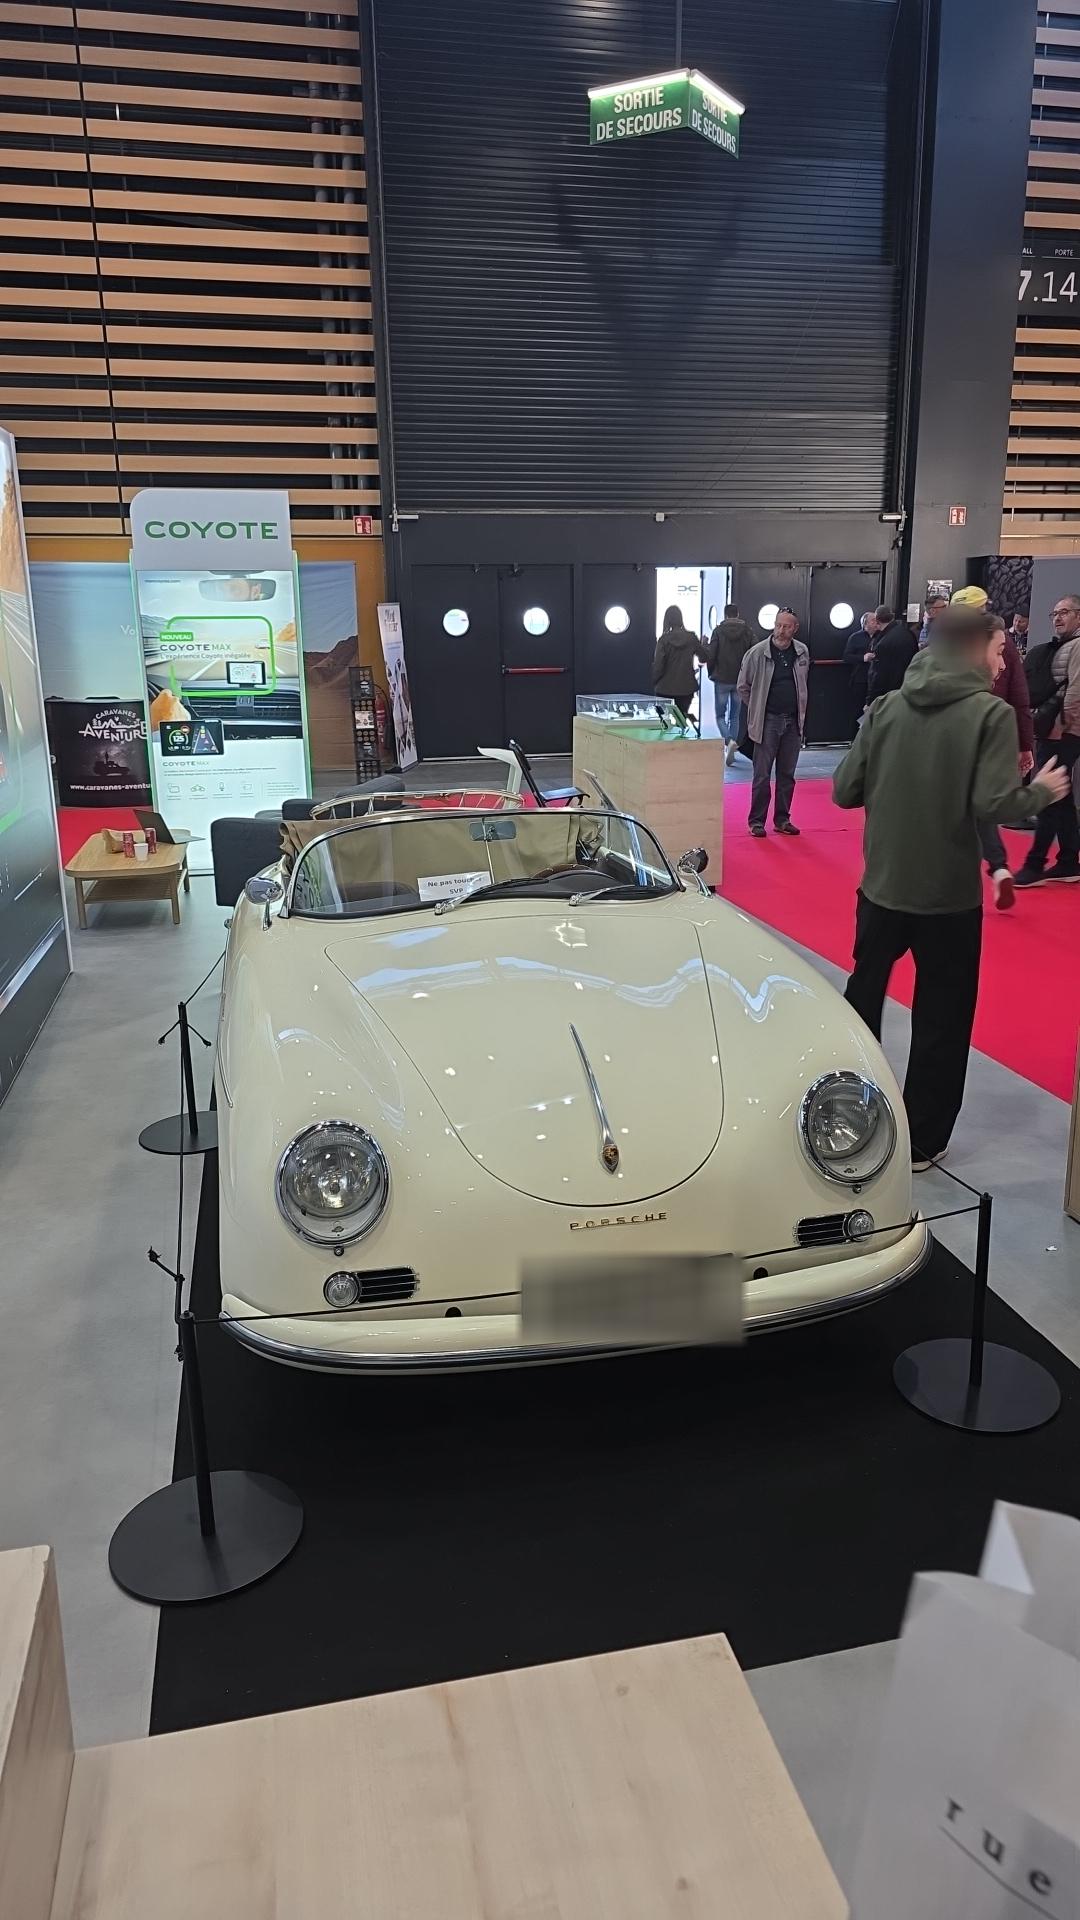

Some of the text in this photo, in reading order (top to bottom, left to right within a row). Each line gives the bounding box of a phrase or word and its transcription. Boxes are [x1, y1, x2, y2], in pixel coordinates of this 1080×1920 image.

[614, 86, 665, 113] SORTIE
[702, 93, 728, 124] SORTIE
[596, 108, 682, 141] DE SECOURS
[692, 109, 736, 153] DE SECOURS
[1054, 248, 1074, 257] PORTE
[1017, 269, 1078, 303] 7.14
[144, 521, 279, 540] COYOTE
[211, 643, 231, 651] MAX
[95, 709, 137, 719] CARAVANES
[454, 877, 482, 885] touchr
[569, 1212, 667, 1231] PORSCHE
[946, 1797, 1053, 1896] rue
